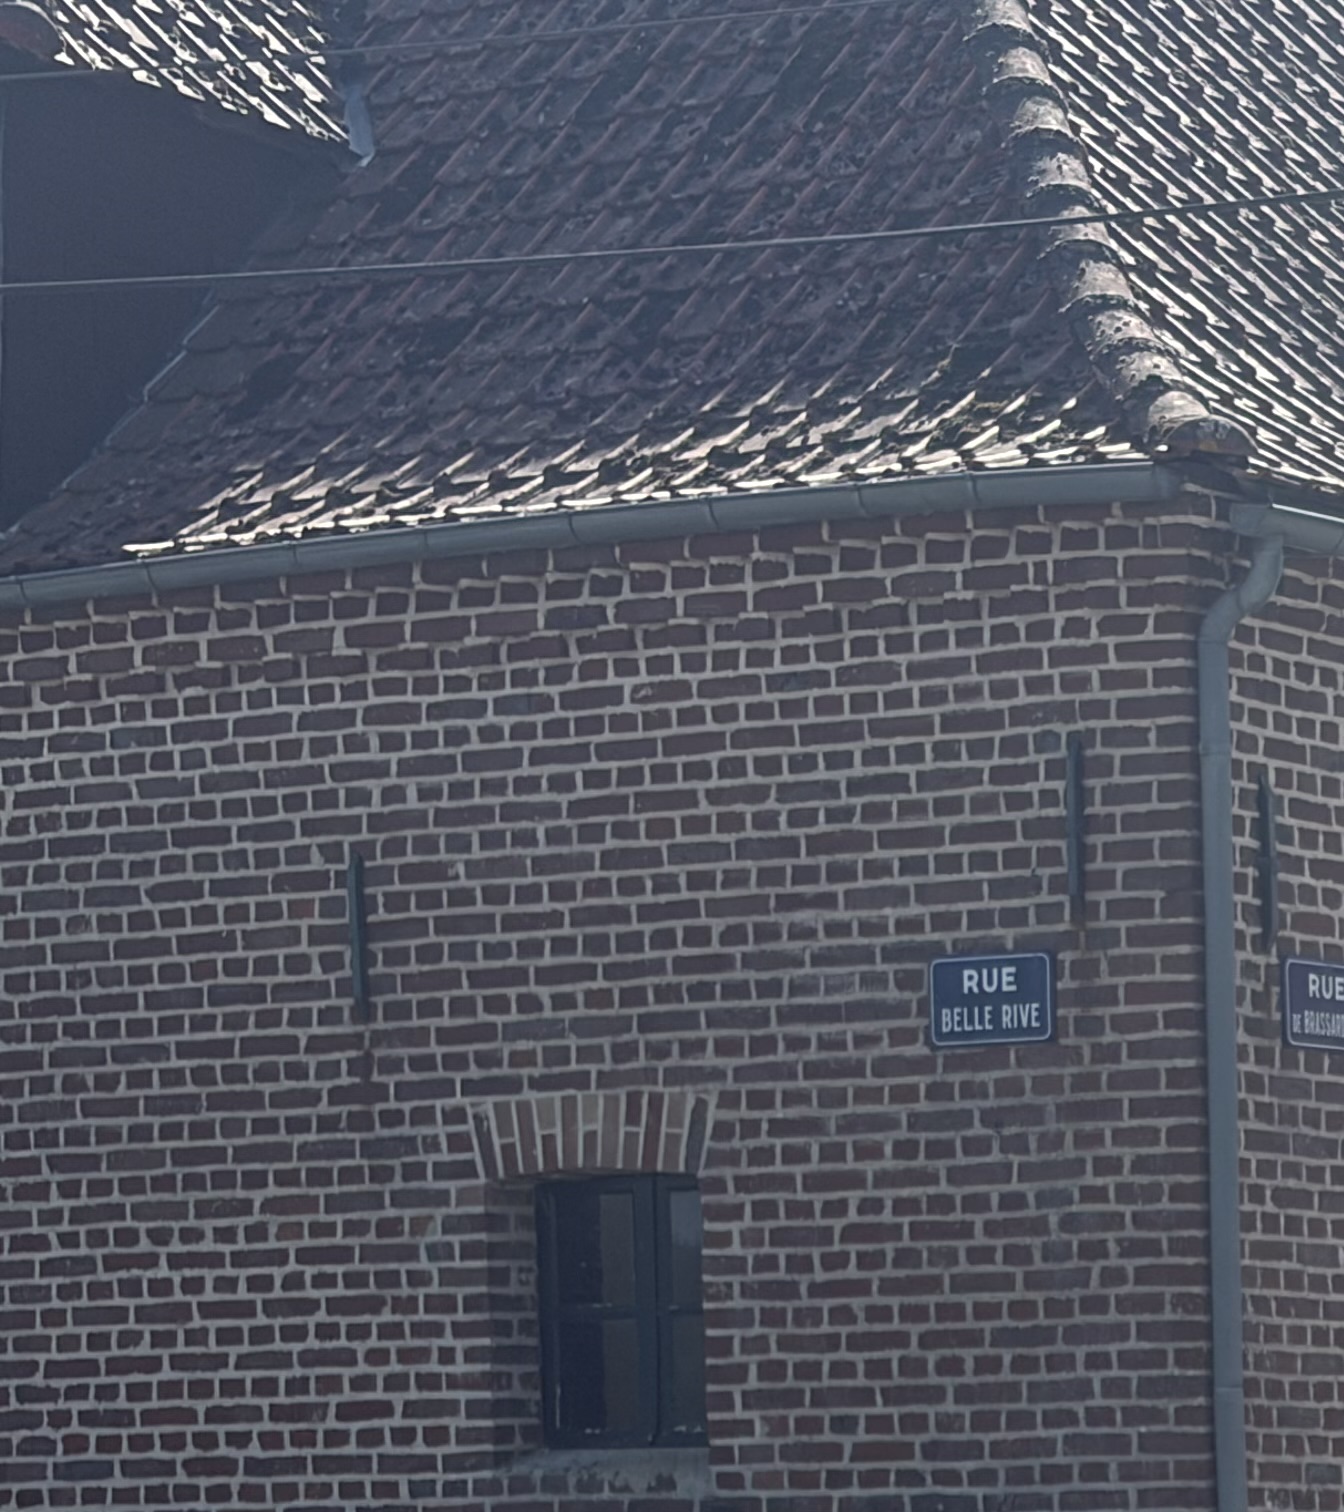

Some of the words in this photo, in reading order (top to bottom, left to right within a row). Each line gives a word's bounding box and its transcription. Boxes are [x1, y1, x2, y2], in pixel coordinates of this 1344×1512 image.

[963, 966, 1017, 994] RUE
[941, 1006, 993, 1033] BELLE
[1001, 1003, 1041, 1029] RIVE
[1292, 1013, 1302, 1034] DE
